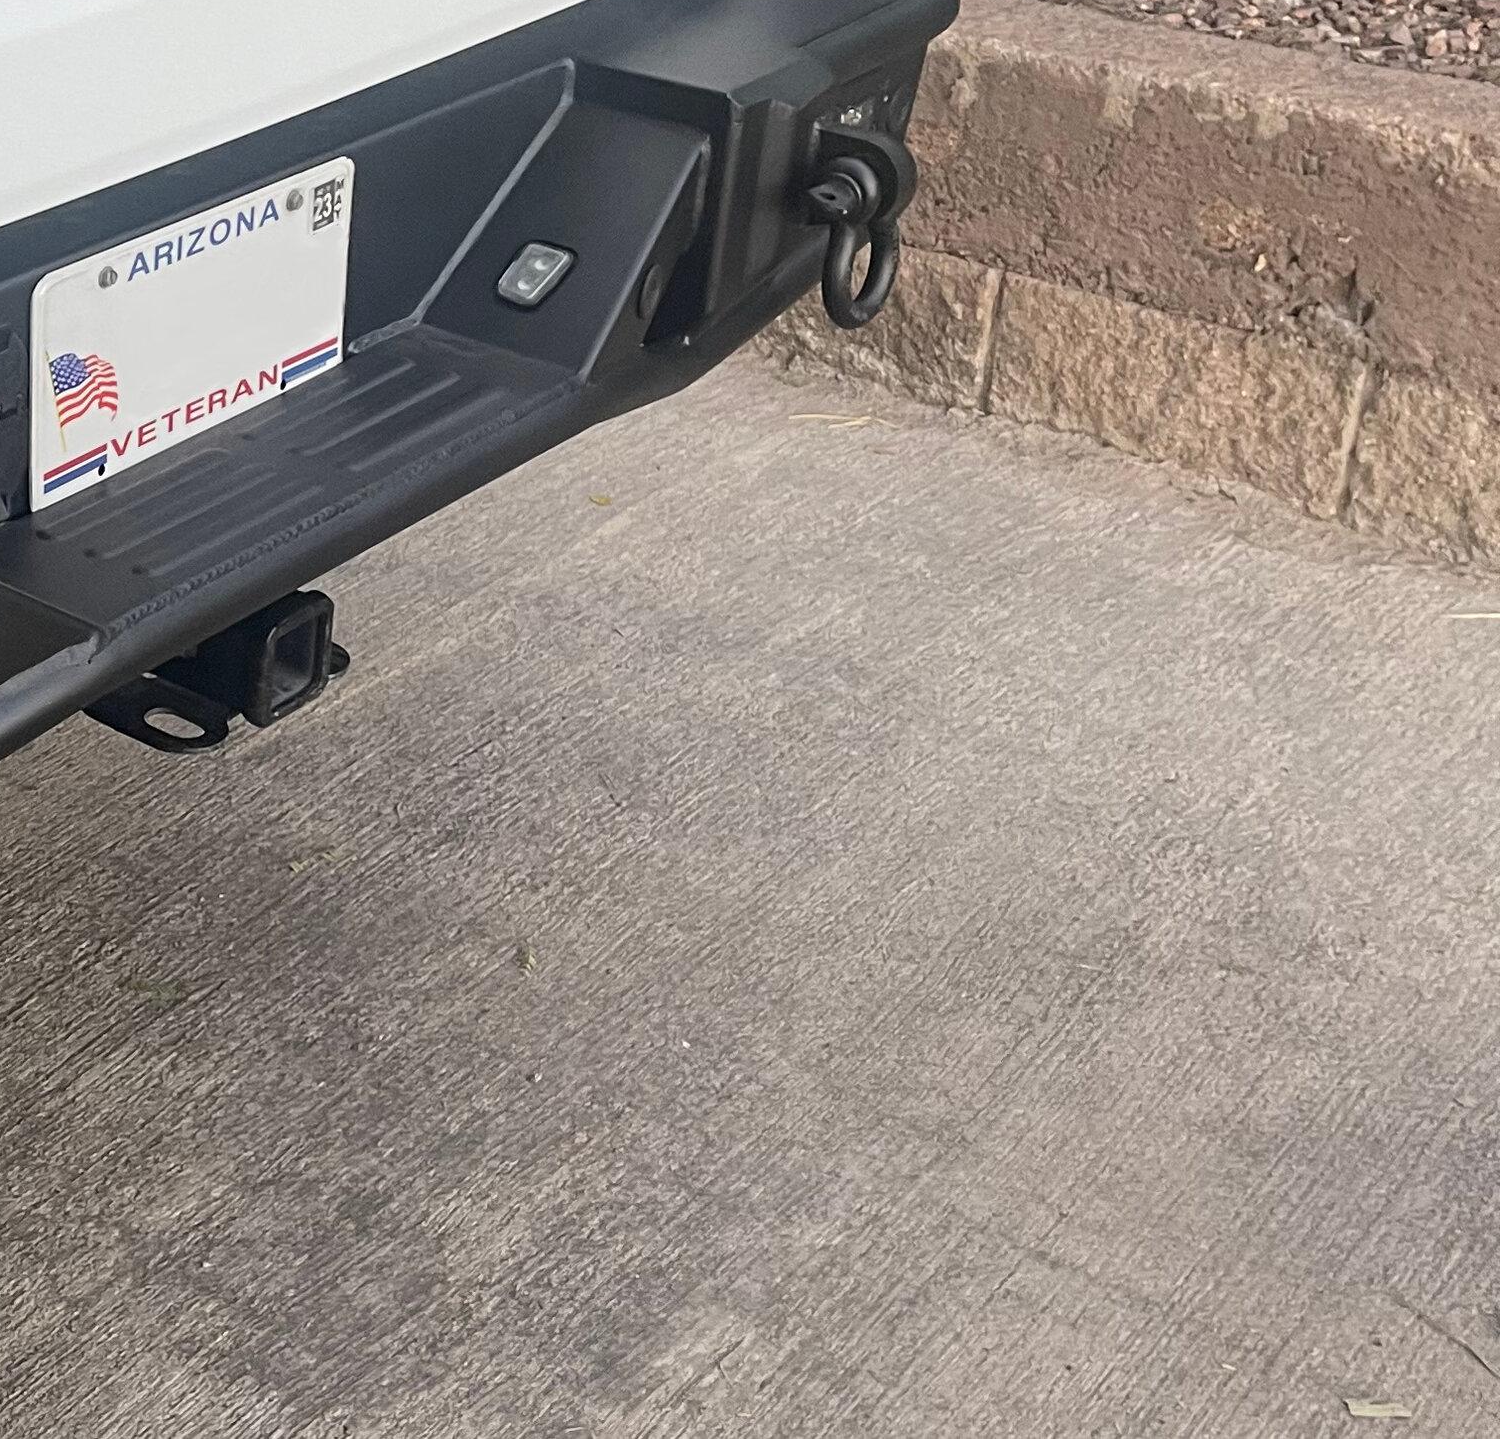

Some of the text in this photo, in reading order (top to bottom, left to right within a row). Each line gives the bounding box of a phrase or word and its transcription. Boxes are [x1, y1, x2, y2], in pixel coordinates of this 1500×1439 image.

[127, 199, 280, 282] ARIZONA
[313, 192, 332, 222] 23
[111, 365, 279, 457] VETERAN
